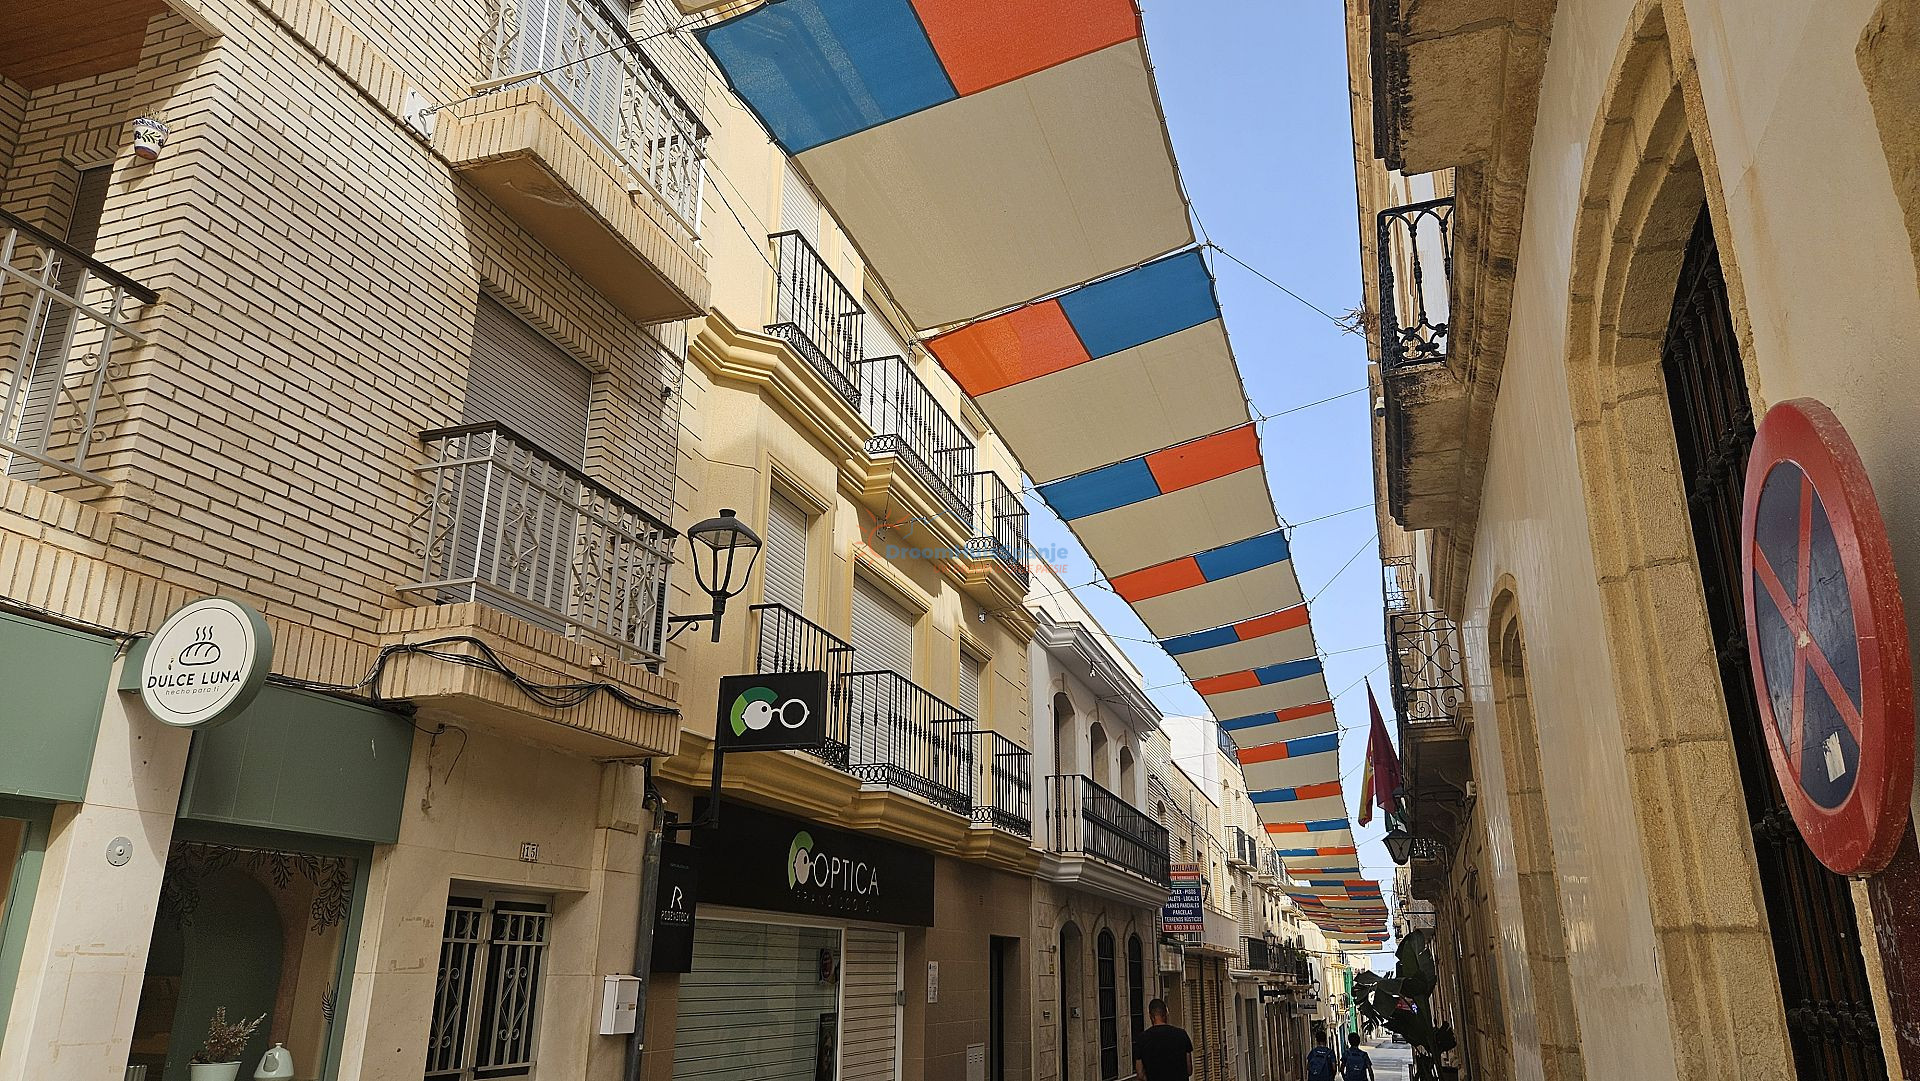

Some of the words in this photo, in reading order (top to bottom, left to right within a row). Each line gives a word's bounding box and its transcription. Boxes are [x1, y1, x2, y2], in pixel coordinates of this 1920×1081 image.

[147, 673, 196, 689] DULCE
[201, 671, 241, 685] LUNA
[193, 687, 213, 696] para
[525, 846, 536, 858] 15
[1171, 864, 1199, 872] OBILIARIA
[670, 886, 683, 910] R
